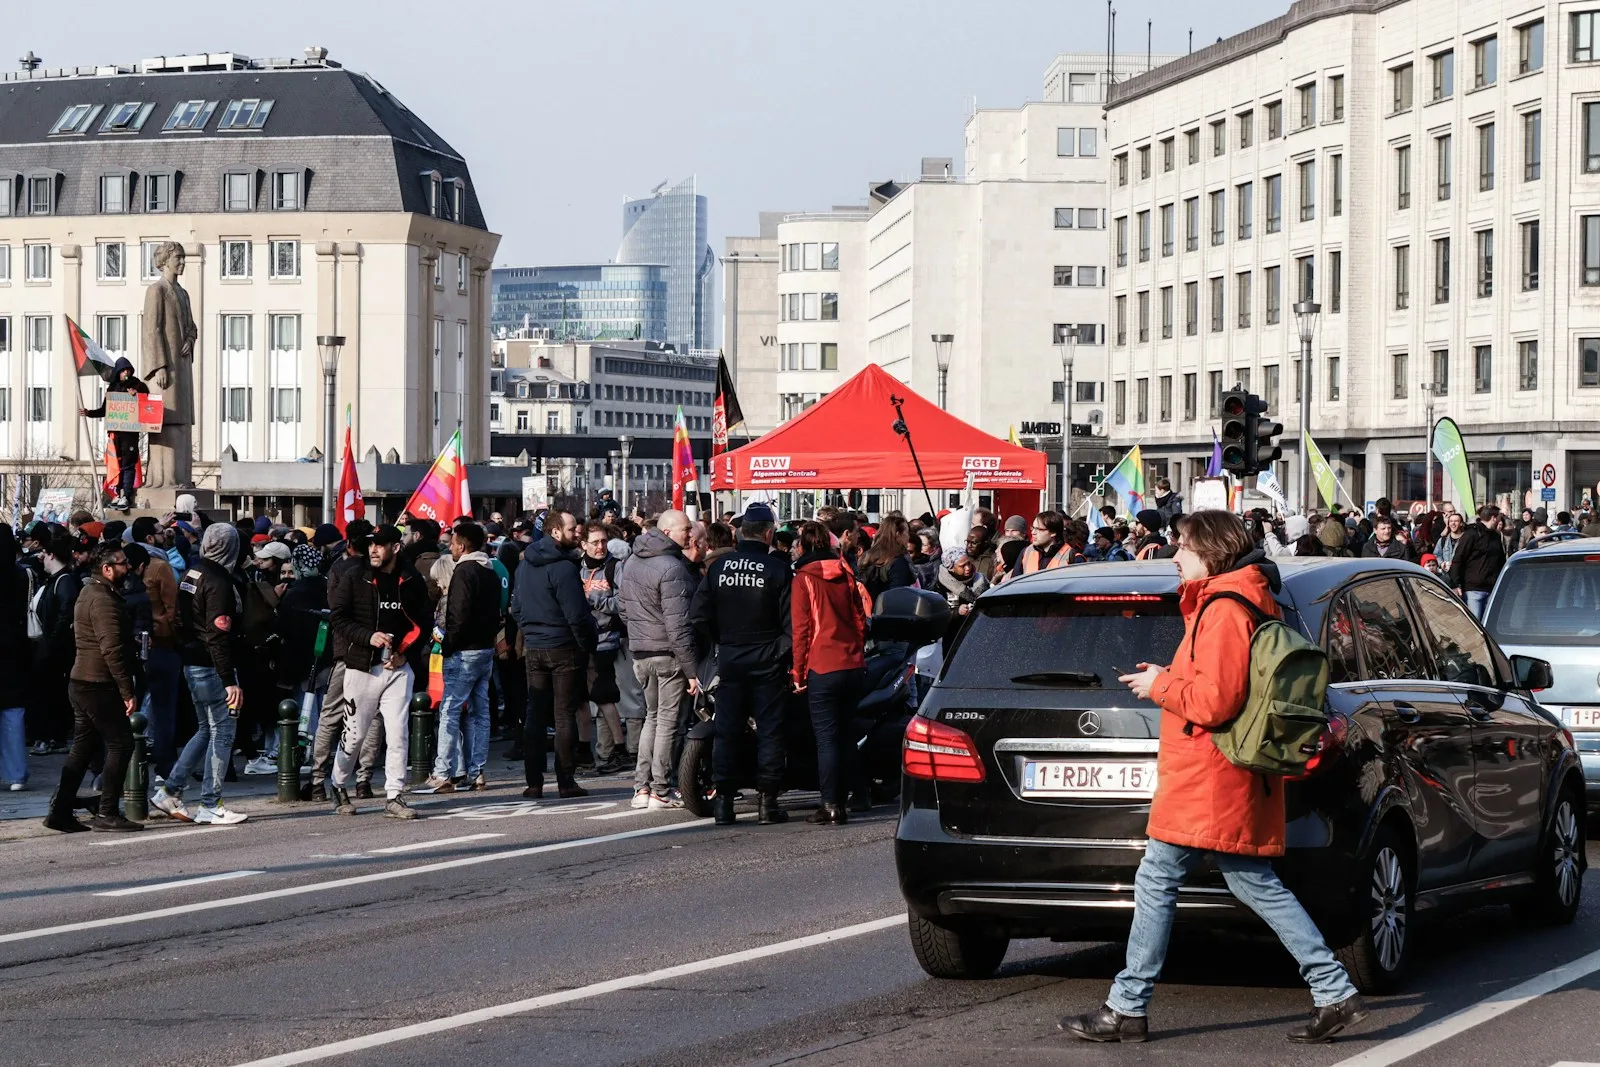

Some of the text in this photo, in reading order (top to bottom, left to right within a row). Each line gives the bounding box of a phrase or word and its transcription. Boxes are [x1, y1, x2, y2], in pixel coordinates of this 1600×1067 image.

[108, 402, 136, 413] RIGHTS
[108, 412, 129, 420] HAVE
[753, 459, 787, 468] ABVV
[965, 459, 998, 468] FGTB
[418, 503, 438, 520] ptb
[723, 558, 765, 572] Police
[718, 572, 765, 588] Politie
[945, 712, 953, 720] B
[954, 712, 978, 720] 200
